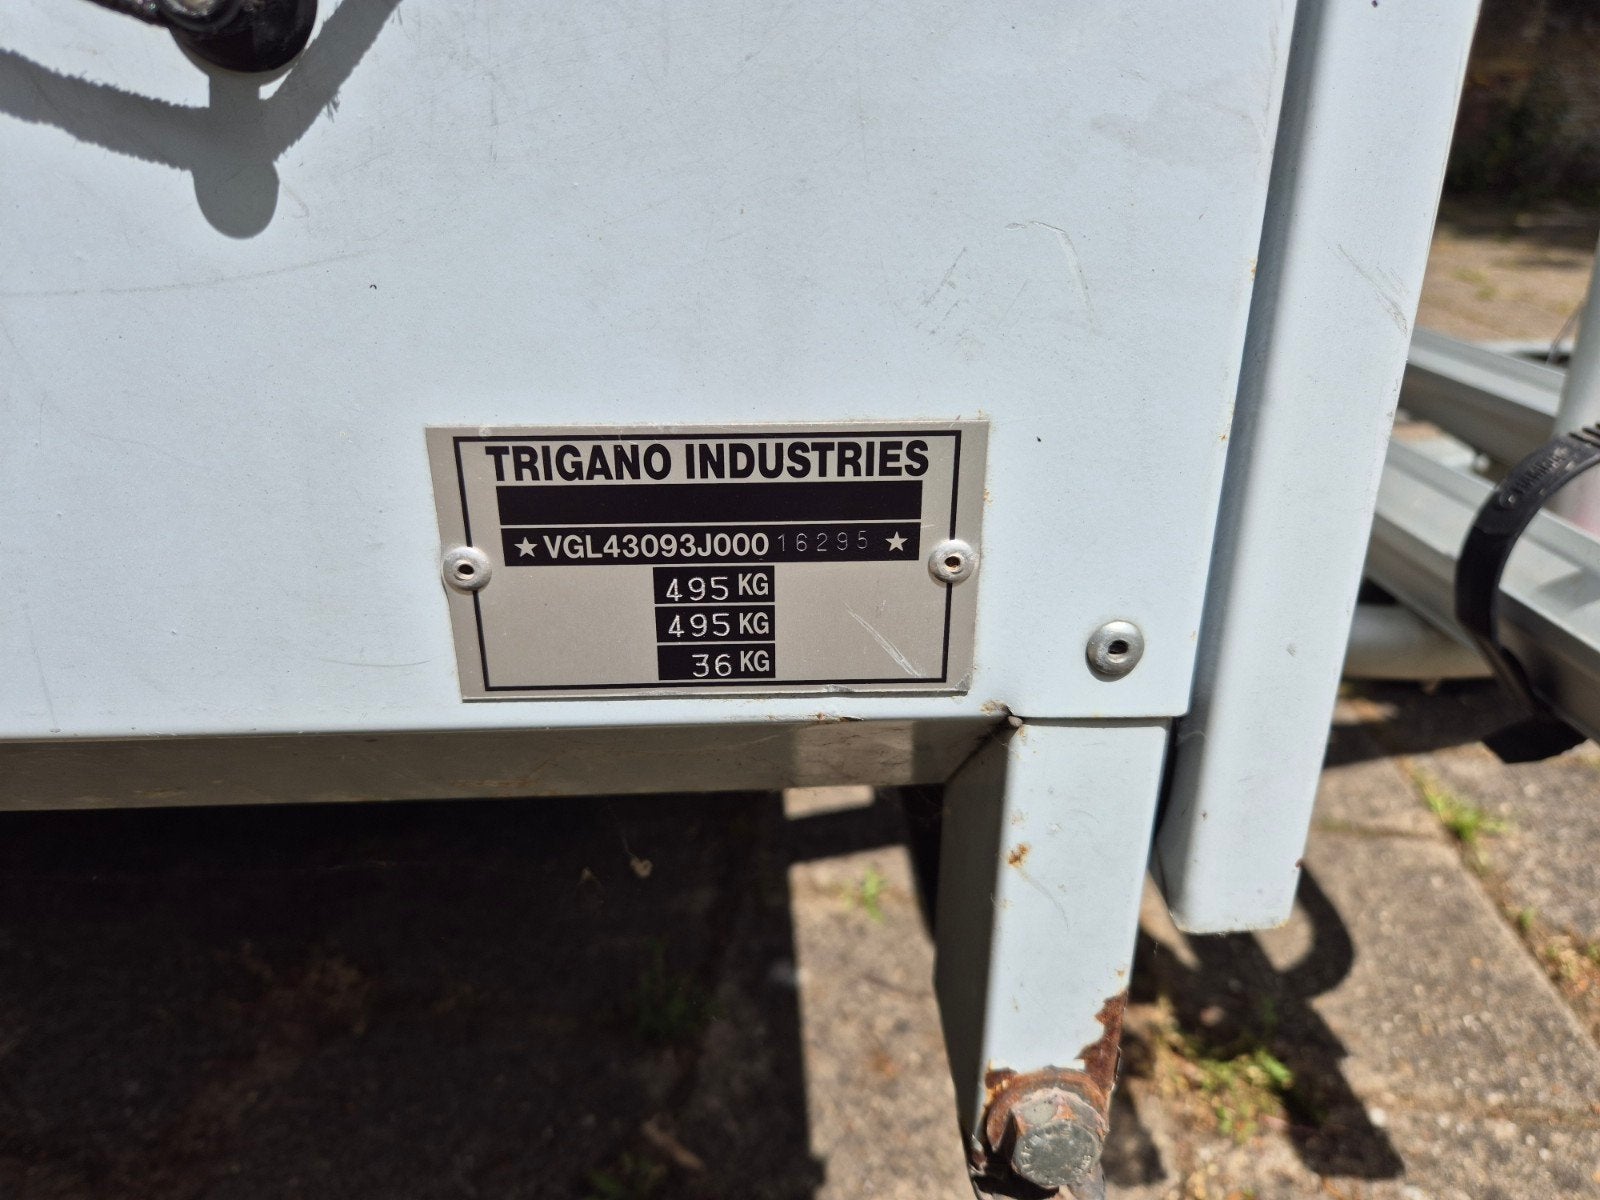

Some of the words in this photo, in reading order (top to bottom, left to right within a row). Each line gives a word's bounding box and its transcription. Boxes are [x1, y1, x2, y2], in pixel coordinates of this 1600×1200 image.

[486, 443, 672, 482] TRIGANO
[685, 439, 930, 480] INDUSTRIES
[665, 576, 730, 602] 495
[737, 572, 769, 596] KG
[668, 612, 731, 638] 495
[739, 611, 770, 635] KG
[691, 653, 733, 678] 36
[739, 649, 770, 673] KG
